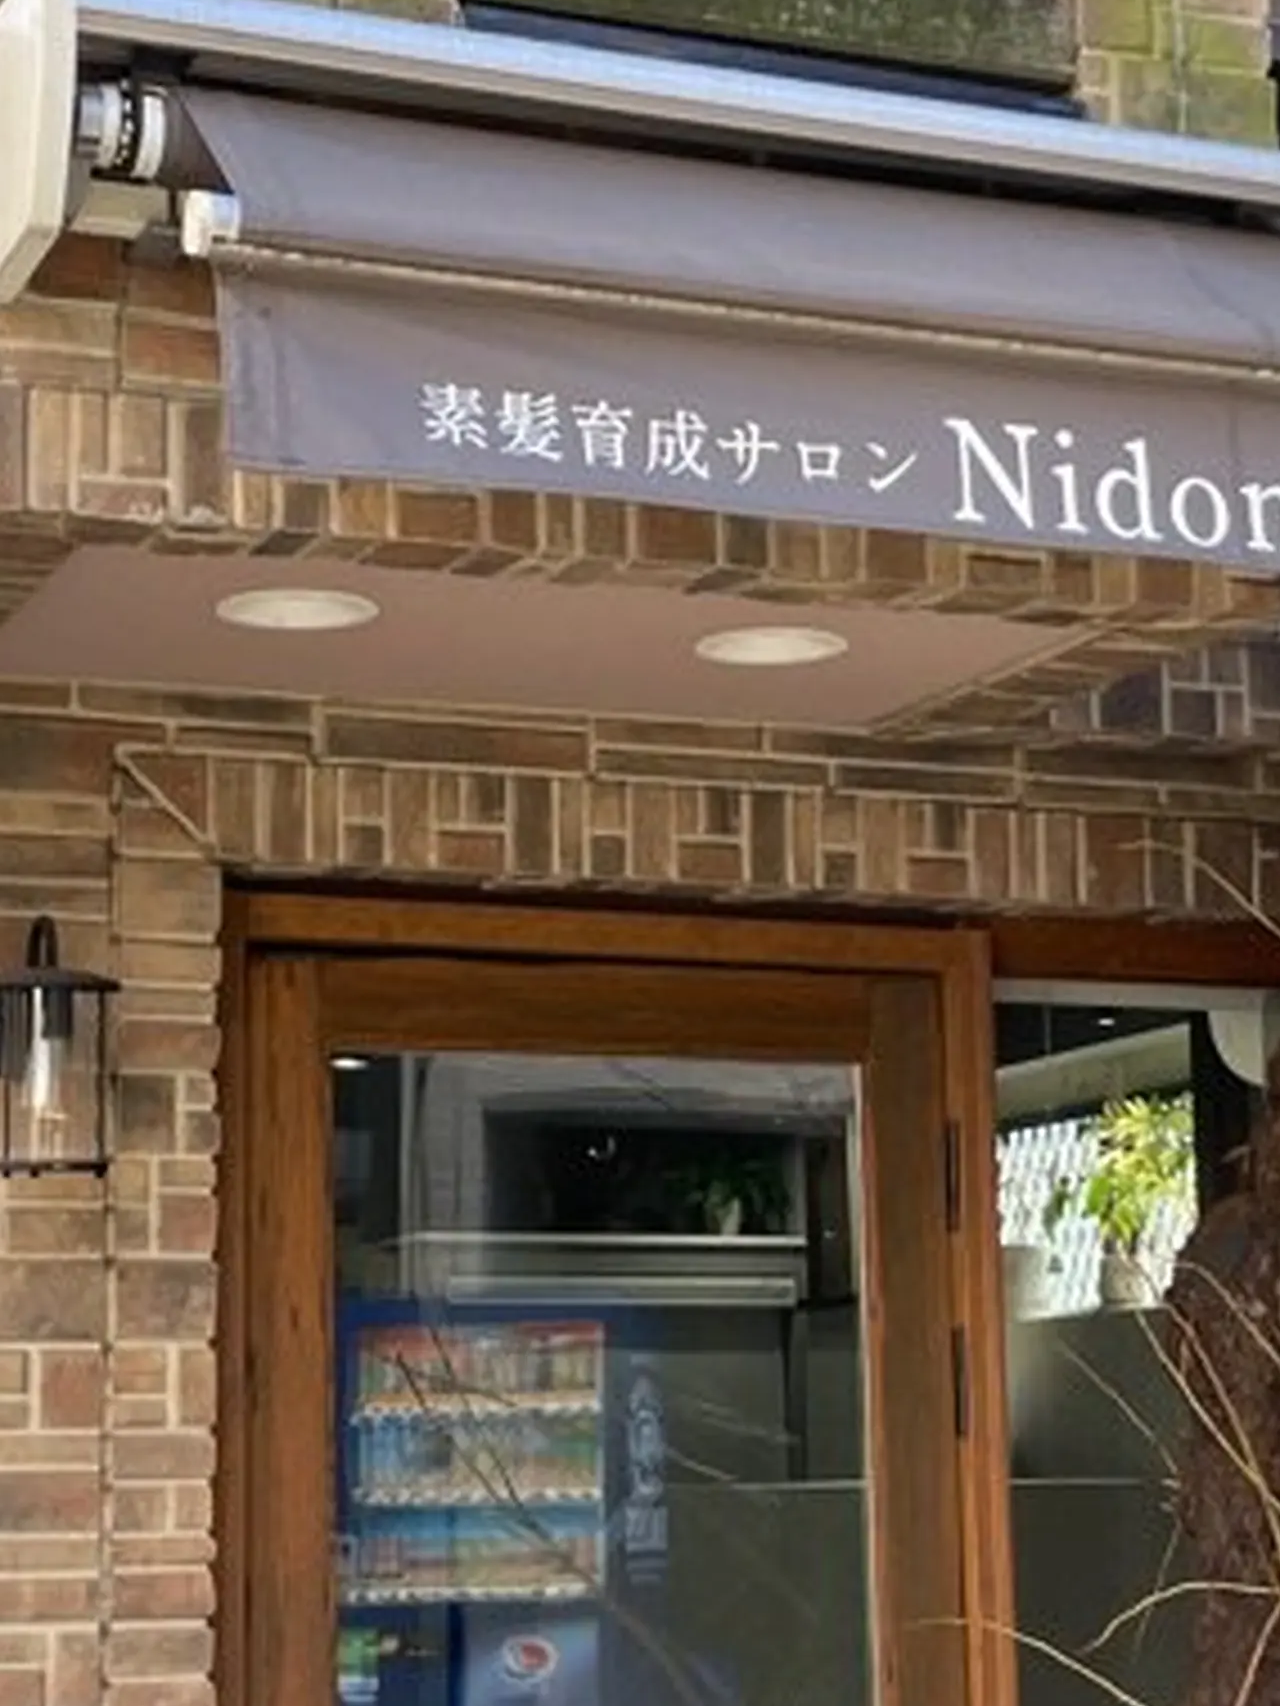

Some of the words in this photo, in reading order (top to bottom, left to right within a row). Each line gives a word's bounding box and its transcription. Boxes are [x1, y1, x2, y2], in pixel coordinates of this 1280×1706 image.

[419, 382, 919, 494] 素髪育成サロン
